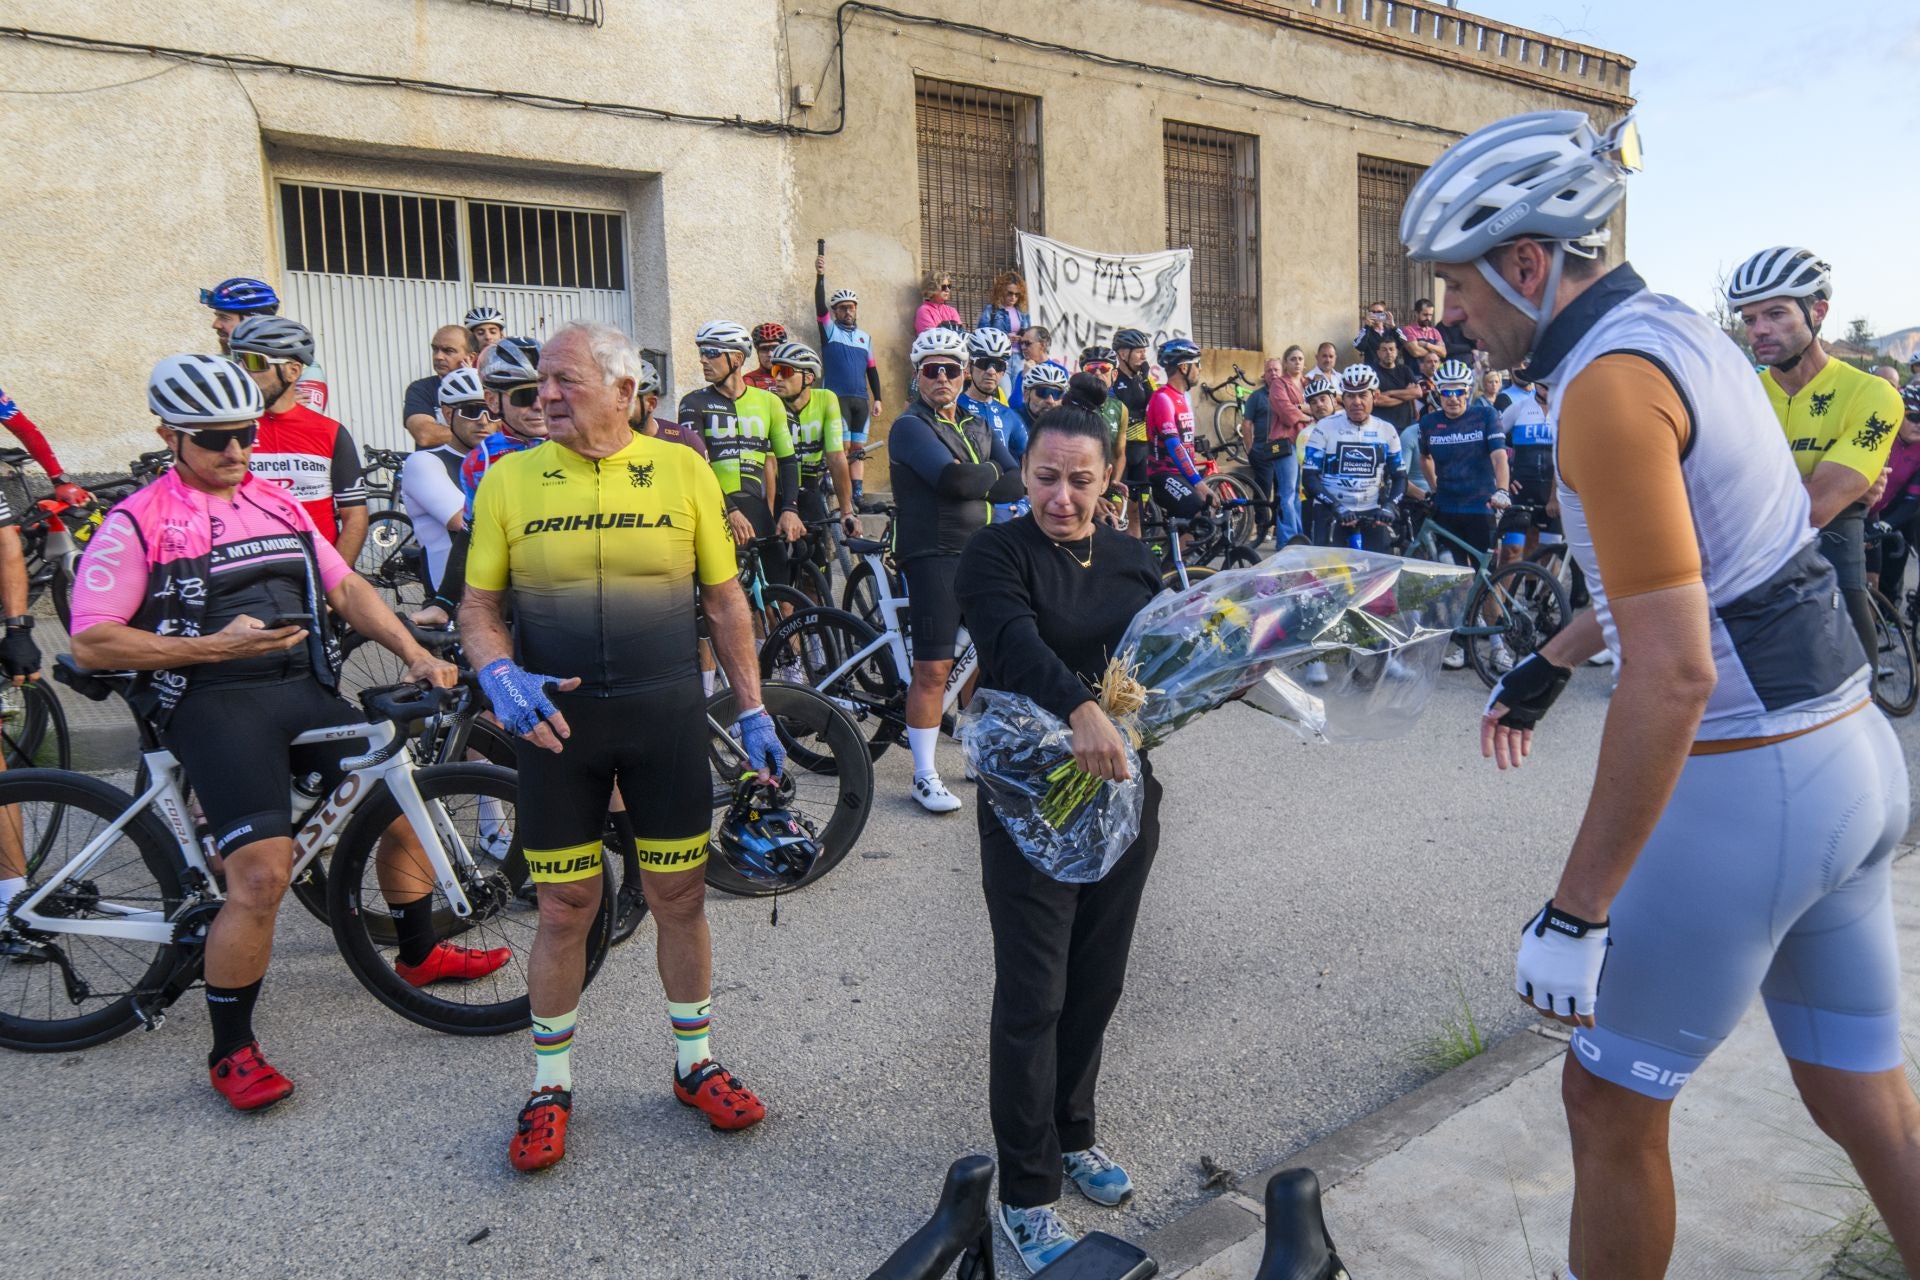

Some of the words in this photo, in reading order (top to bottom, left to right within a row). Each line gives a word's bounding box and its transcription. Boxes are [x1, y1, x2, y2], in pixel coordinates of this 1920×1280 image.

[1035, 248, 1080, 296] NO
[1091, 256, 1145, 304] MÁS
[1429, 430, 1484, 445] gravelMurcia
[293, 459, 327, 473] Team
[523, 512, 674, 536] ORIHUELA
[226, 541, 262, 559] MTB
[779, 618, 803, 639] SWISS
[804, 614, 819, 625] DT
[501, 674, 528, 707] WHOOP
[325, 729, 356, 739] EVO
[164, 798, 191, 846] COBRA
[639, 843, 709, 866] ORIHU
[1550, 917, 1580, 934] SIROKO
